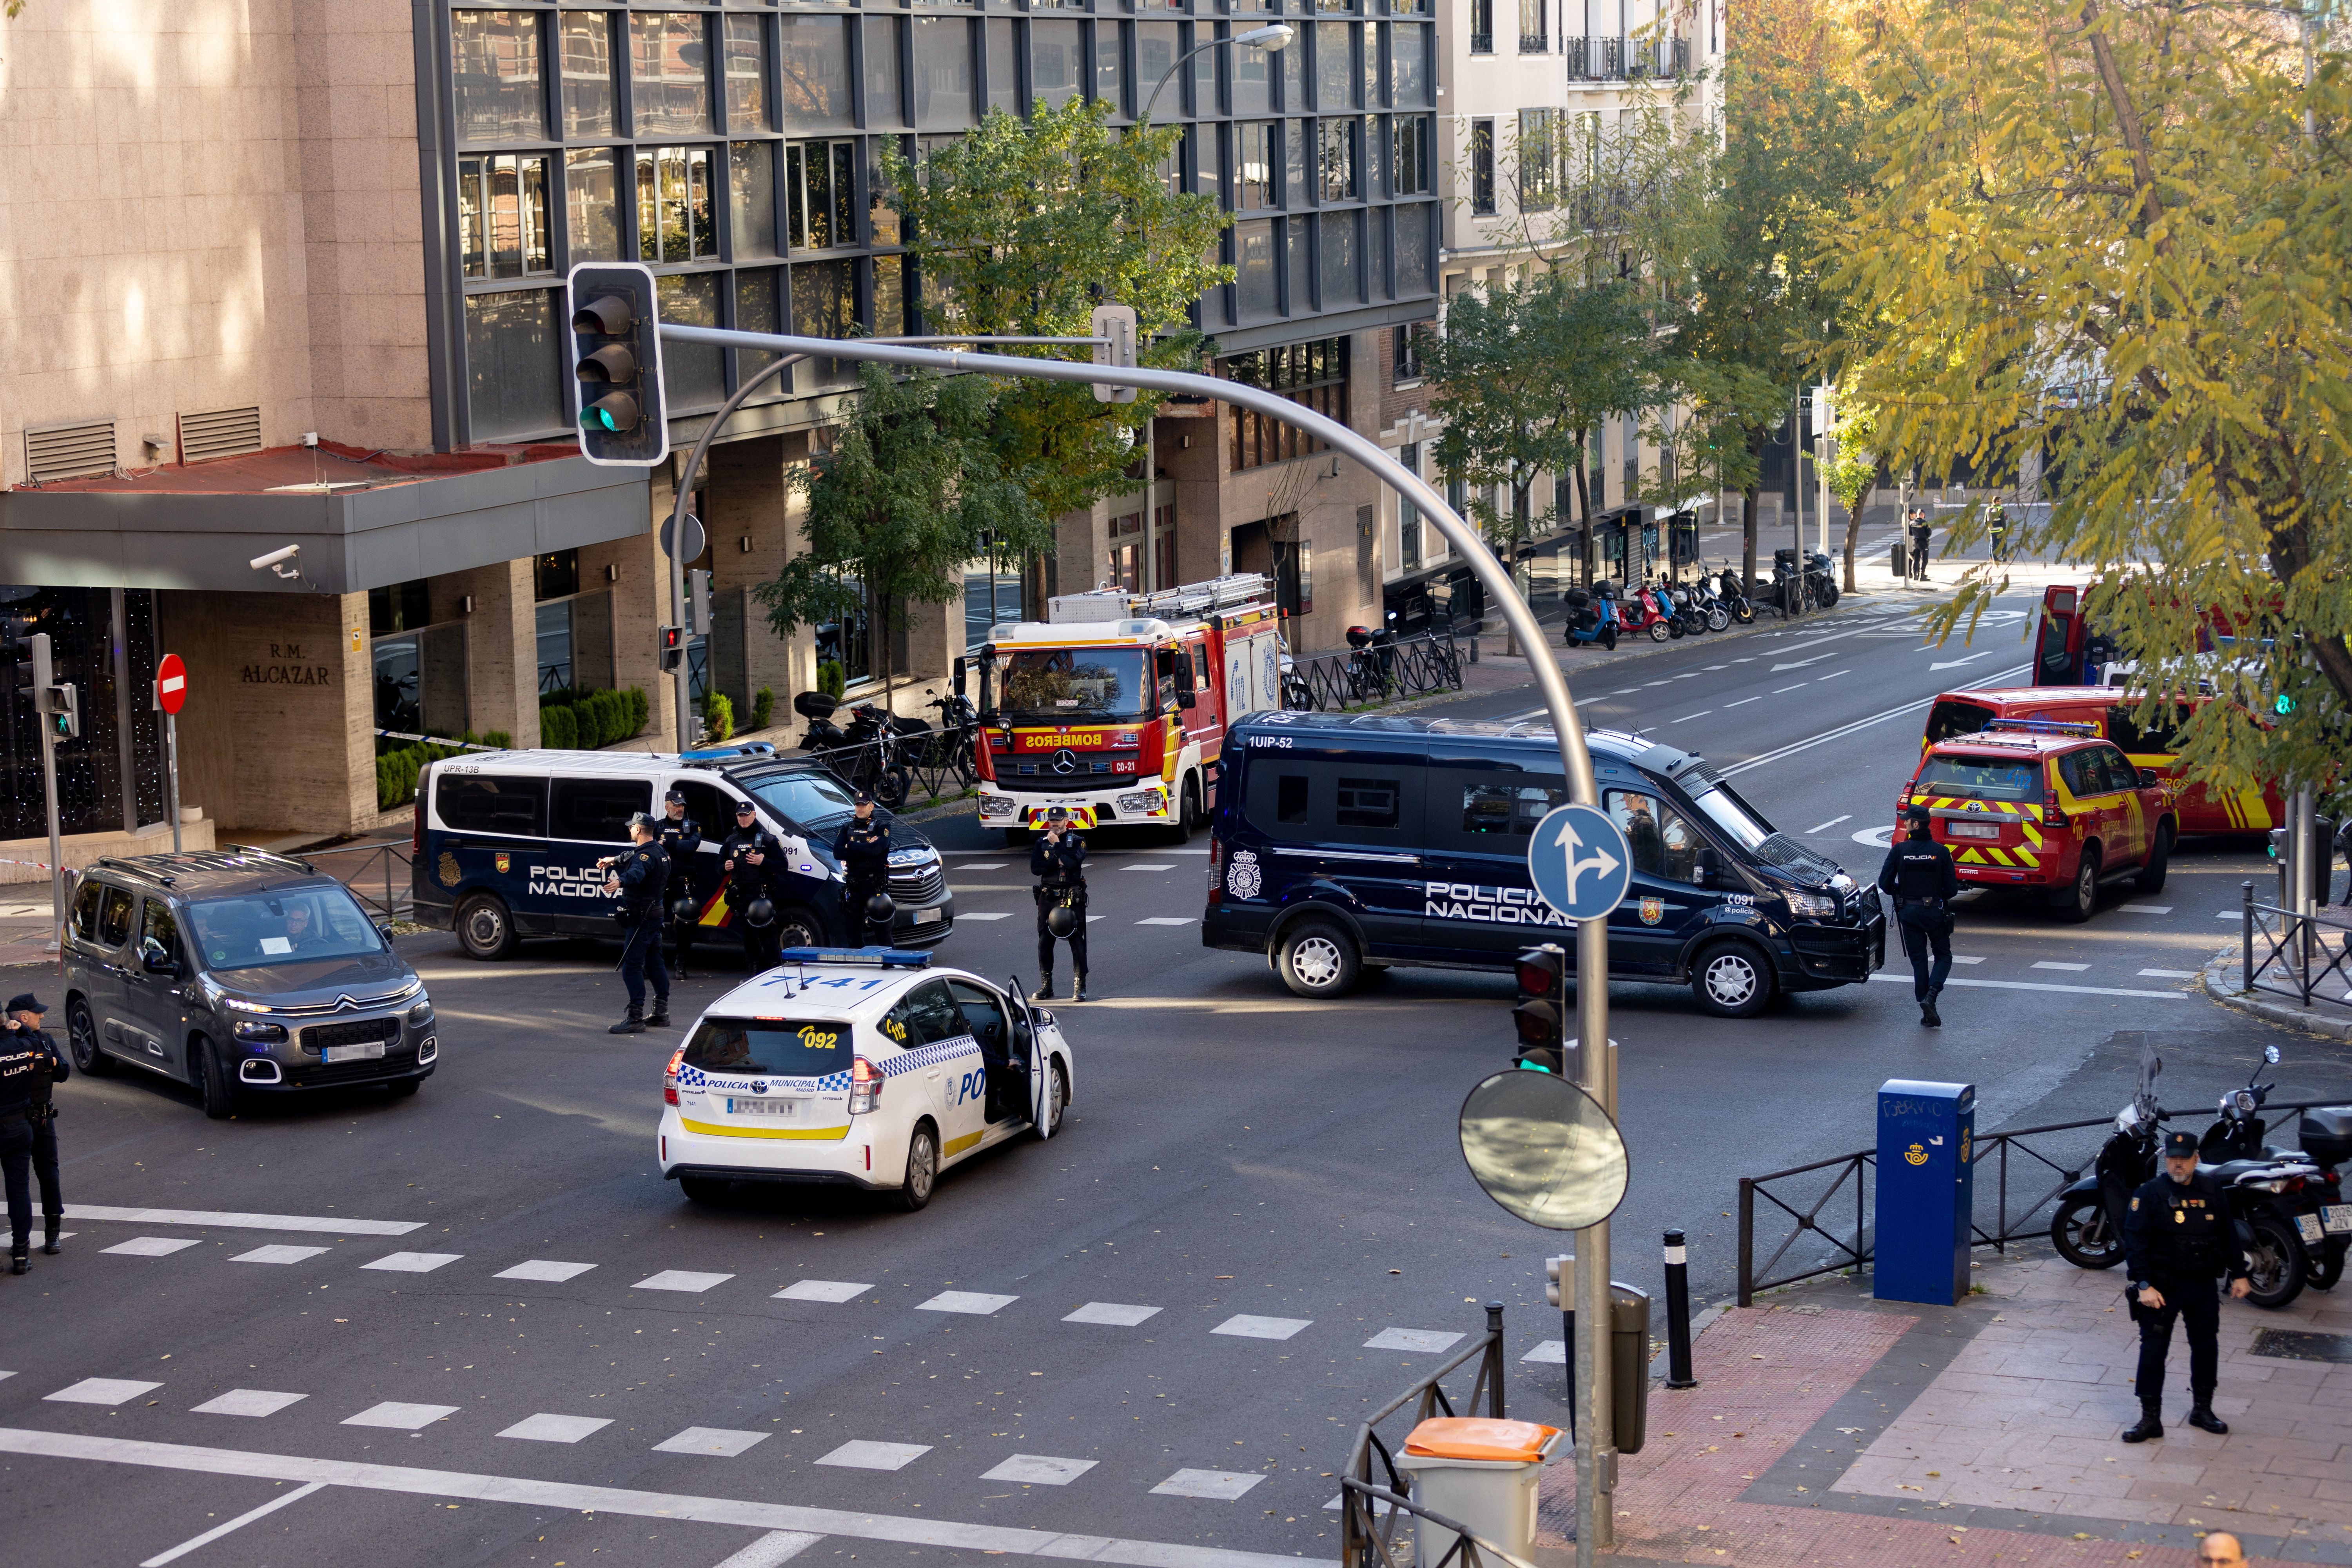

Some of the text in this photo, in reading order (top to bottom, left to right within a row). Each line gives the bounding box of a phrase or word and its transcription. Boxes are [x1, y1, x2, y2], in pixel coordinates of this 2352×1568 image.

[1643, 528, 1657, 546] blue
[242, 665, 330, 685] ALCAZAR
[1236, 675, 1245, 711] 112
[1249, 736, 1292, 748] 1UIP-52
[444, 765, 479, 773] UPR-13B
[2014, 774, 2032, 789] 112
[784, 847, 798, 855] 091
[529, 882, 623, 898] NACIONA
[1734, 895, 1754, 906] 091
[1724, 906, 1754, 915] @policia
[760, 975, 884, 990] 7141
[891, 1022, 907, 1041] 112
[804, 1032, 837, 1049] 092
[4, 1065, 29, 1077] U.I.P.
[707, 1080, 815, 1090] POLICÍA MUNICIPAL
[957, 1067, 986, 1106] PO
